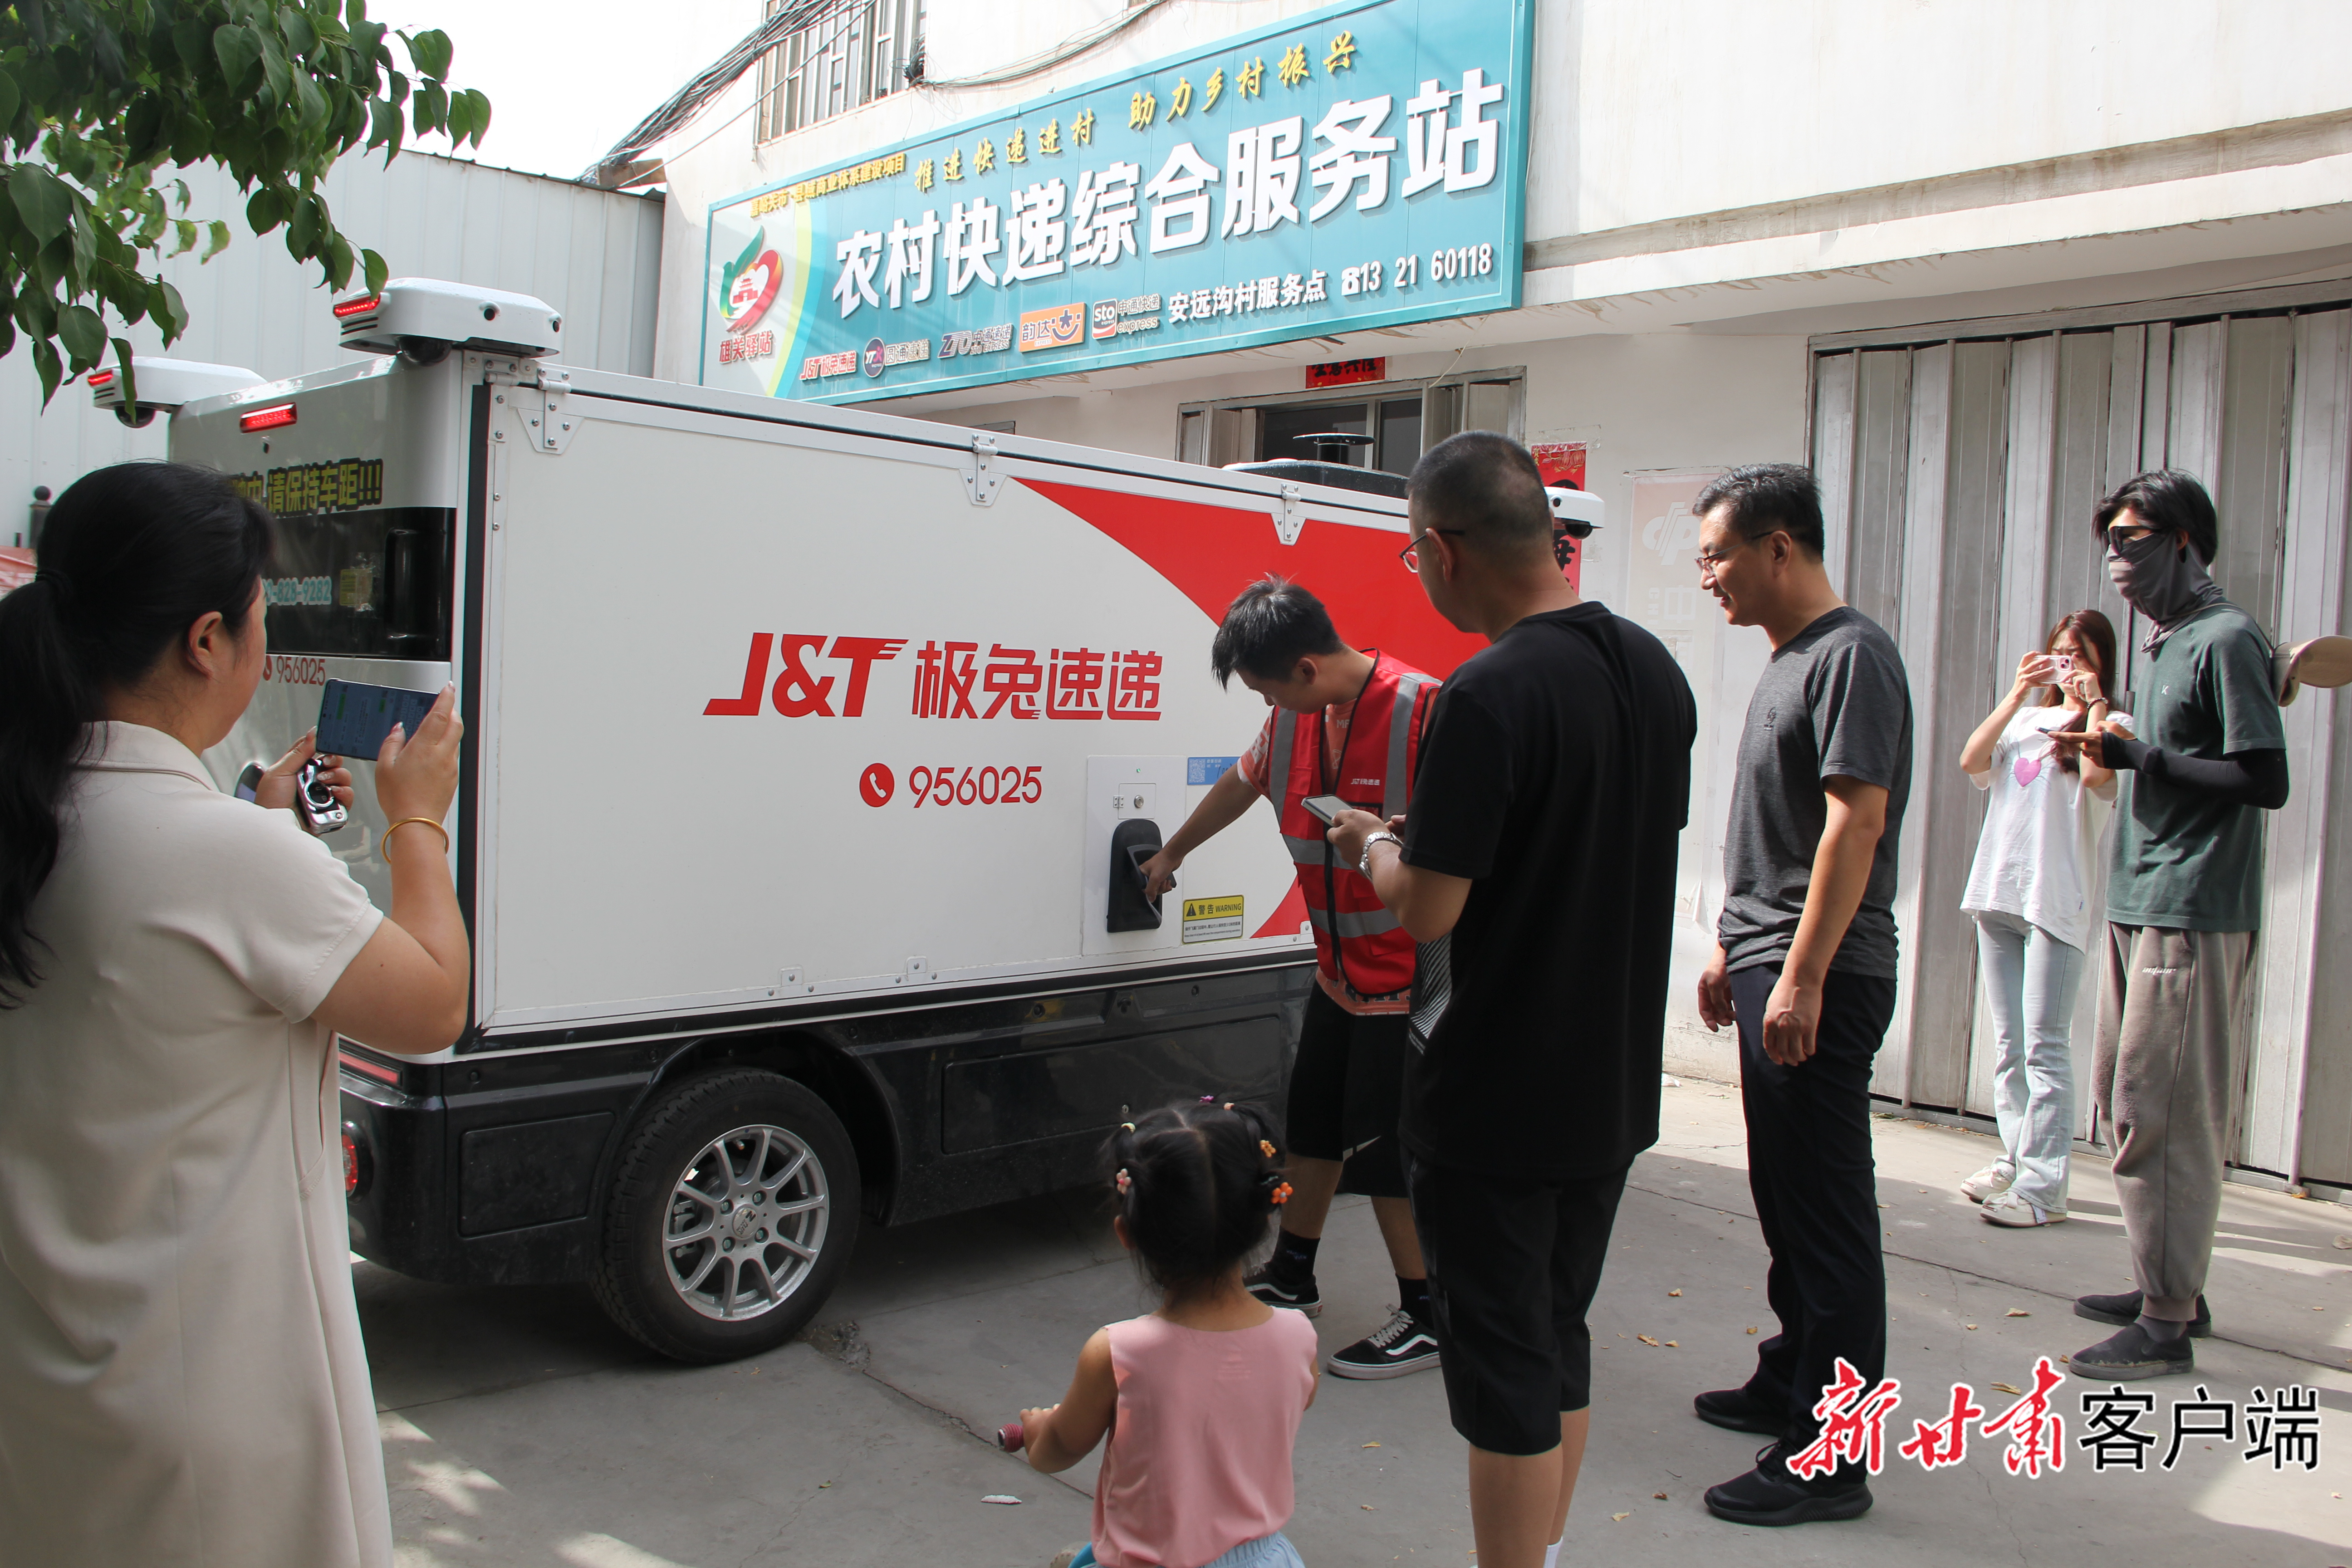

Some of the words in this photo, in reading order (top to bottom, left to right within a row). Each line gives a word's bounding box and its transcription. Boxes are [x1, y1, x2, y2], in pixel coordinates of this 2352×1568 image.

[1128, 30, 1356, 131] 助力乡村振兴
[914, 108, 1095, 193] 推进快递进村
[833, 68, 1504, 319] 农村快递综合服务站
[1168, 269, 1327, 323] 安远沟村服务点
[1394, 254, 1418, 288] 21
[1431, 243, 1493, 282] 60118
[1094, 305, 1115, 322] sto
[1118, 294, 1160, 316] 申通快递
[972, 324, 1013, 343] 中通速递
[1021, 320, 1052, 342] 韵达
[1117, 317, 1158, 335] express
[719, 330, 772, 363] 雄关驿站
[886, 340, 929, 364] 圆通速递
[983, 340, 1009, 352] EXPRESS
[265, 578, 331, 603] 0-828-9282
[277, 655, 326, 686] 956025
[703, 632, 909, 717] J&T
[911, 640, 1163, 720] 极兔速递
[909, 765, 1042, 808] 956025
[1198, 904, 1214, 915] 警告
[1215, 903, 1241, 912] WARNING
